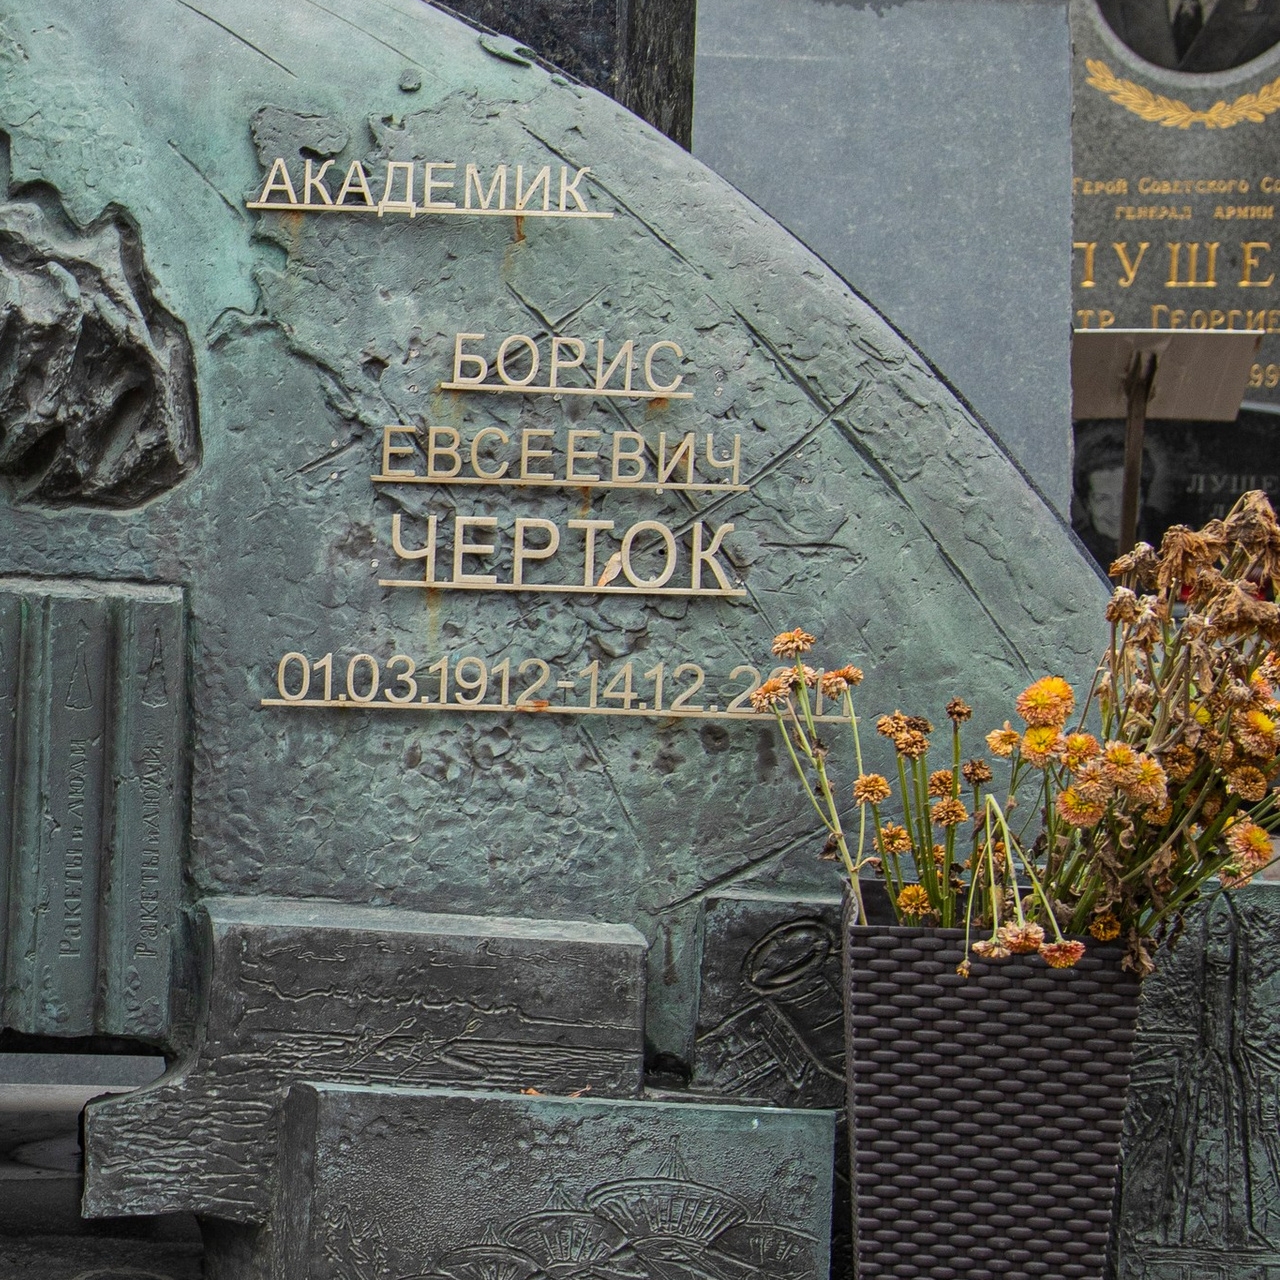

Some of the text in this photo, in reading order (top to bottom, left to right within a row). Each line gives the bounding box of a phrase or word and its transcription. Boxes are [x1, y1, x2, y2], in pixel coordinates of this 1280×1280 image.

[259, 157, 591, 218] АКАДЕМИК
[452, 332, 684, 393] БОРИС
[382, 425, 741, 486] ЕВСЕЕВИЧ
[392, 513, 735, 590] ЧЕРТОК
